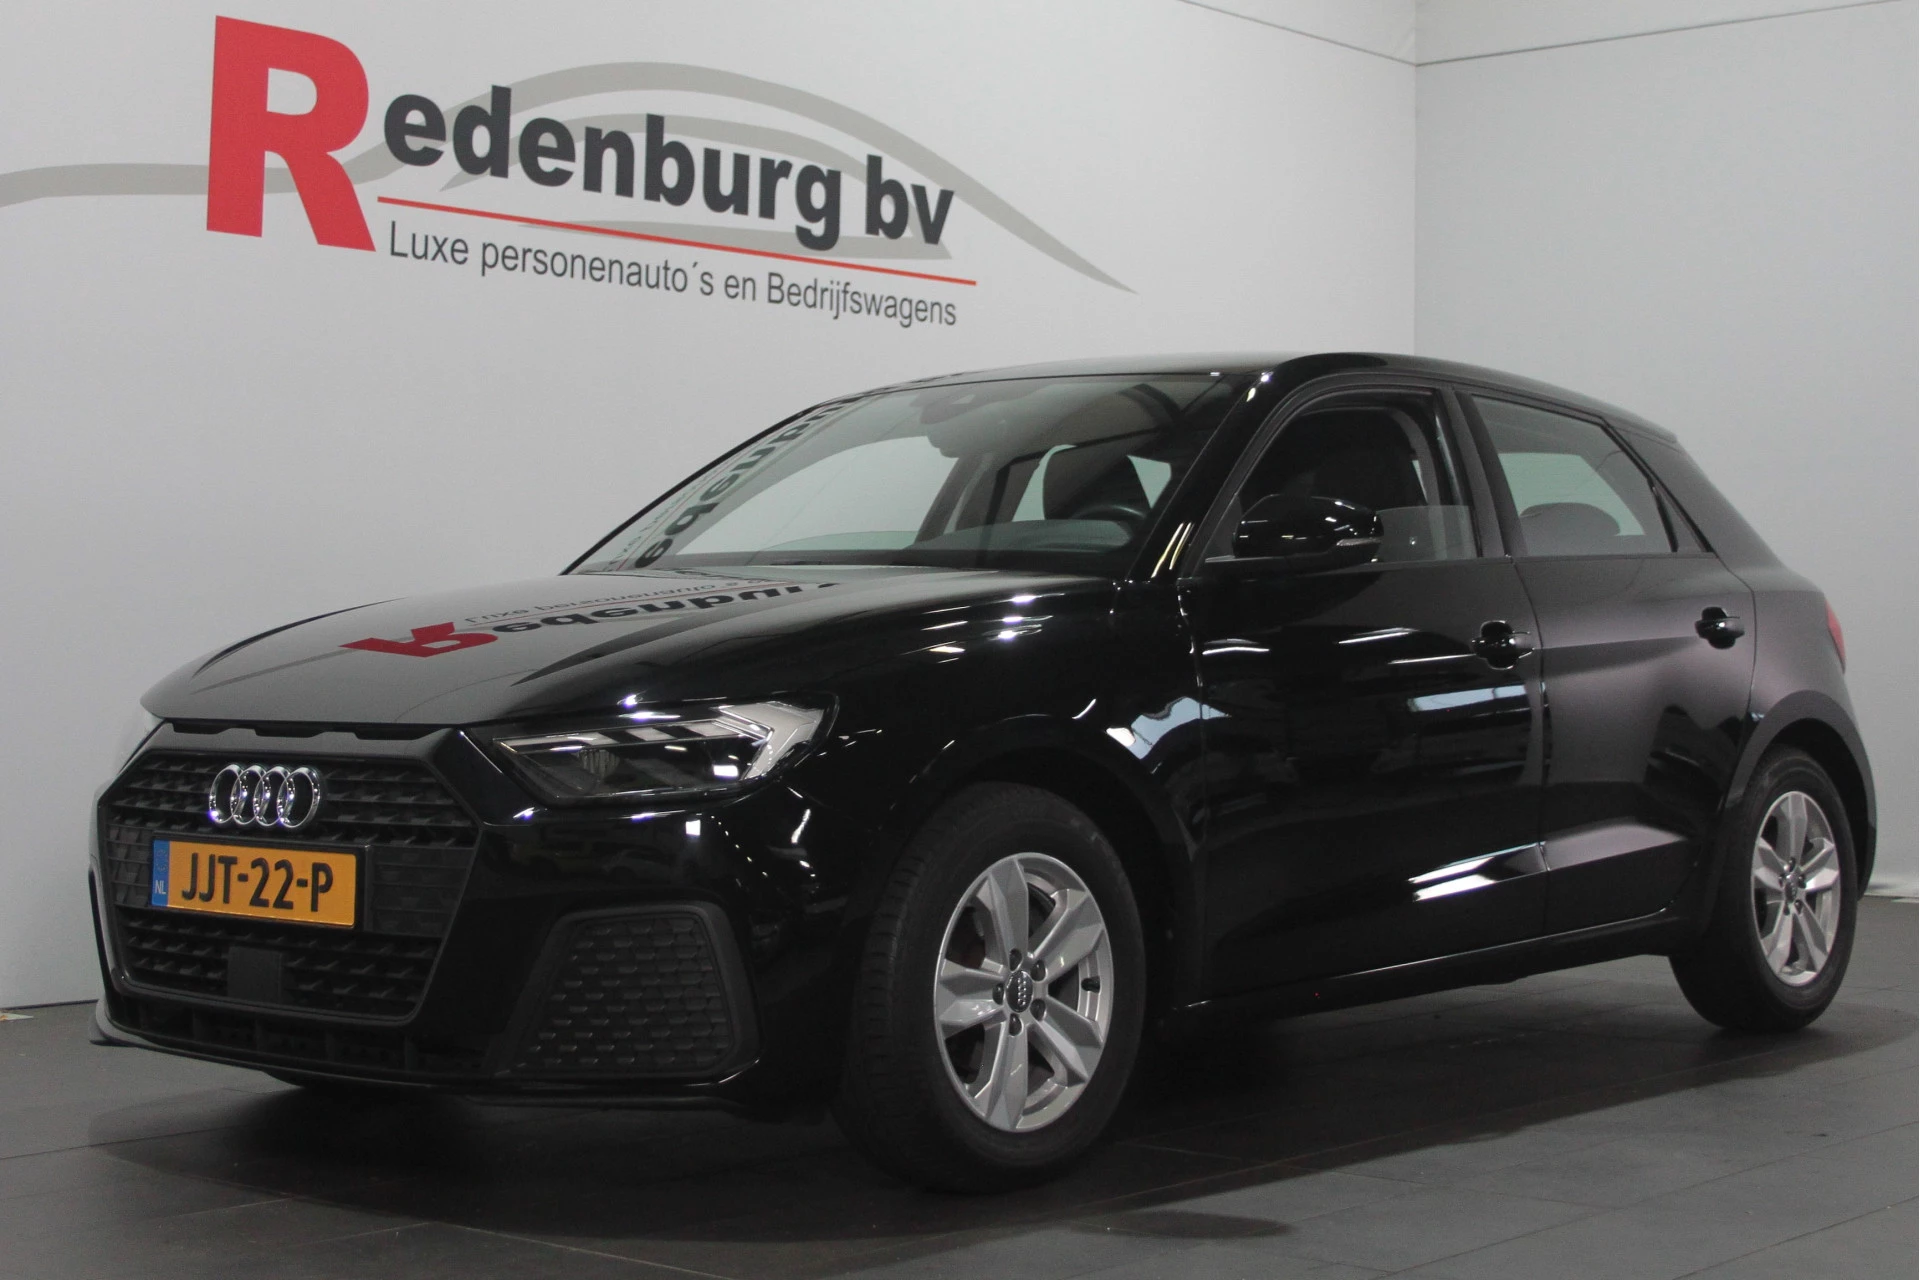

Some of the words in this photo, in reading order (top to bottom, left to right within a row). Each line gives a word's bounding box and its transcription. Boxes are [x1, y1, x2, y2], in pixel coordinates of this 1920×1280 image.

[206, 15, 841, 251] Redenburg
[865, 153, 955, 245] bv
[389, 220, 469, 265] Luxe
[723, 273, 756, 302] en
[767, 271, 957, 328] Bedrijfswagens
[155, 880, 167, 895] NL
[181, 852, 334, 912] JJT-22-P
